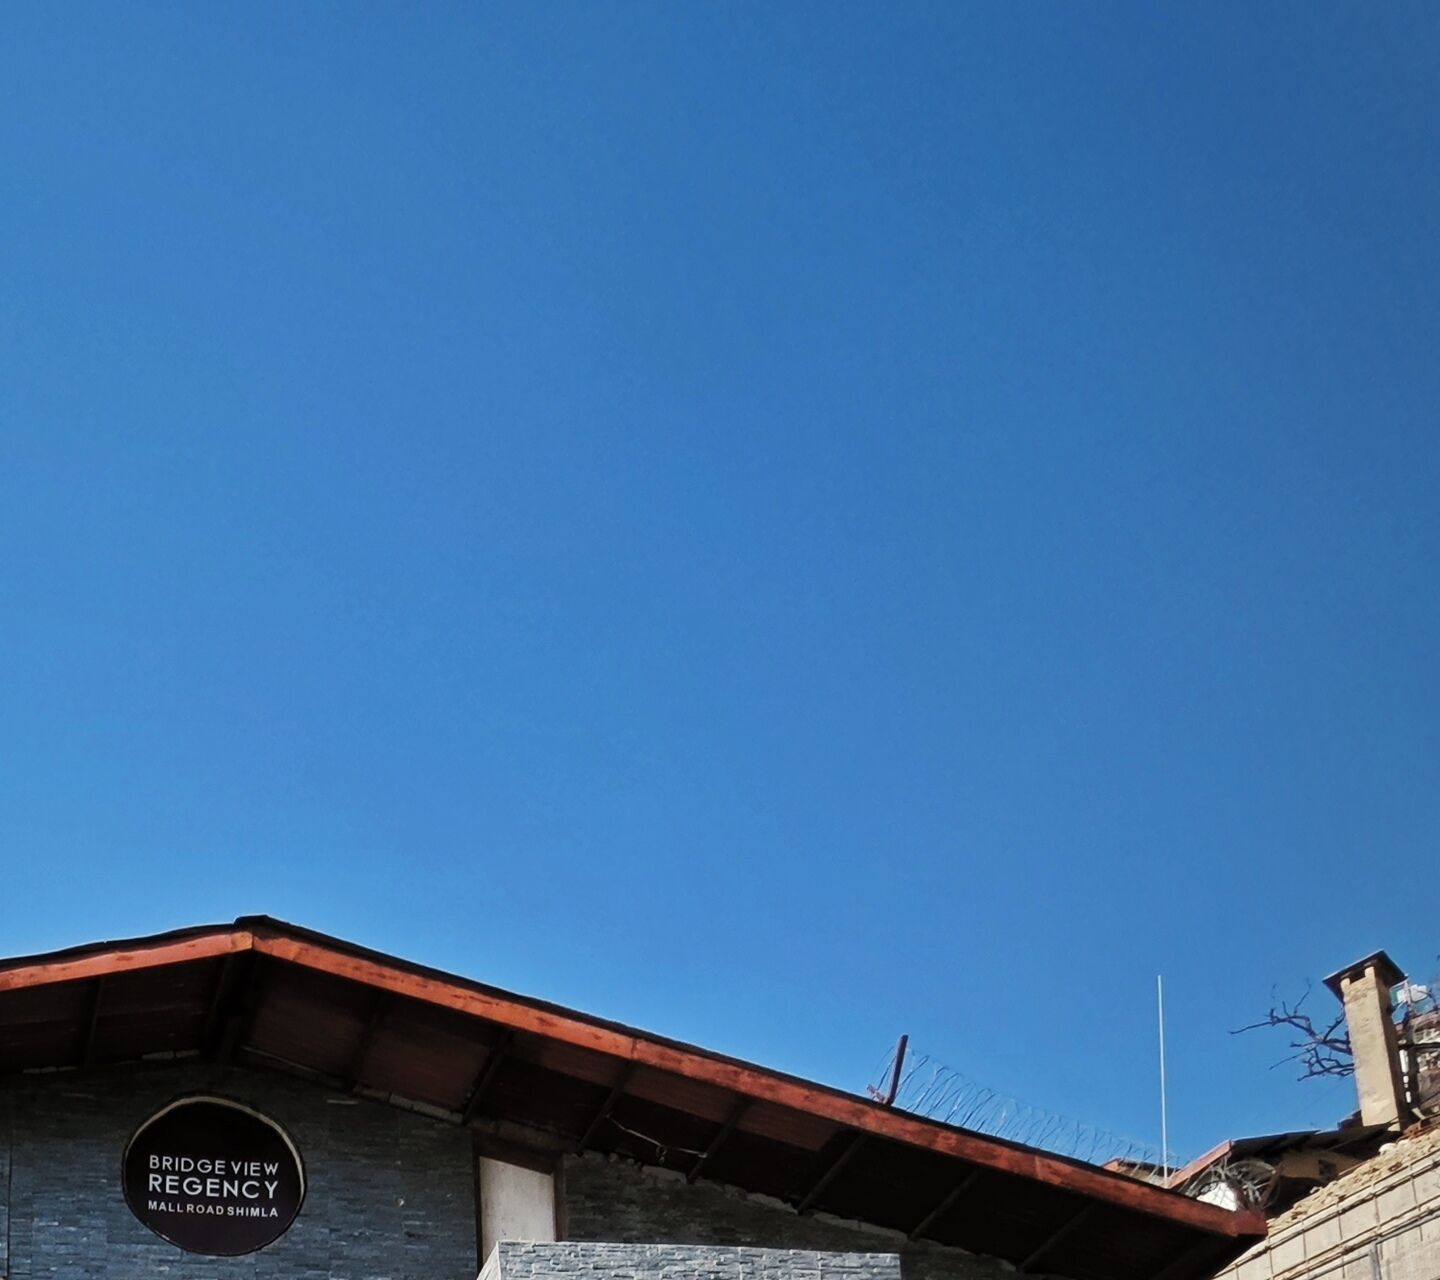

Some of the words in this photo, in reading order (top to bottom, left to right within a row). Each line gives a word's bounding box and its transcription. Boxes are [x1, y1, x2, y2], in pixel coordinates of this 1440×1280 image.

[148, 1173, 279, 1199] REGENCY
[148, 1200, 184, 1213] MALL
[186, 1203, 224, 1216] ROAD
[226, 1206, 279, 1218] SHIMLA
